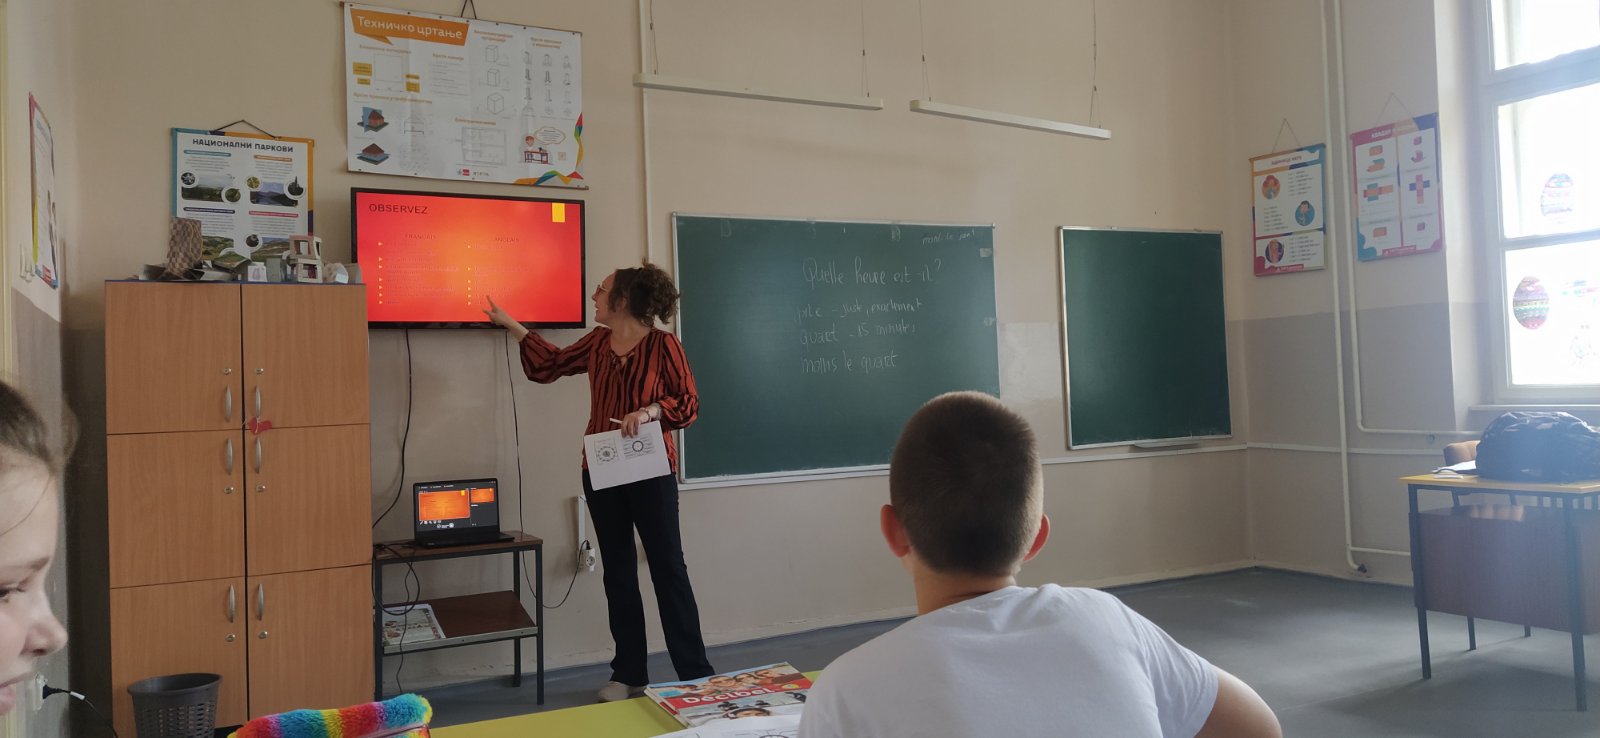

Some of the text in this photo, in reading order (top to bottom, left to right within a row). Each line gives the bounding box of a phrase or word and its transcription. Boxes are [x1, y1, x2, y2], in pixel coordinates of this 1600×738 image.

[356, 15, 415, 33] Техничко
[416, 25, 463, 40] цртање
[192, 138, 294, 153] НАЦИОНАЛНИ ПАРКОВИ
[369, 203, 428, 215] OBSERVEZ
[802, 257, 844, 289] Quelle
[854, 255, 886, 285] heure
[857, 321, 869, 337] 15
[842, 350, 853, 371] le
